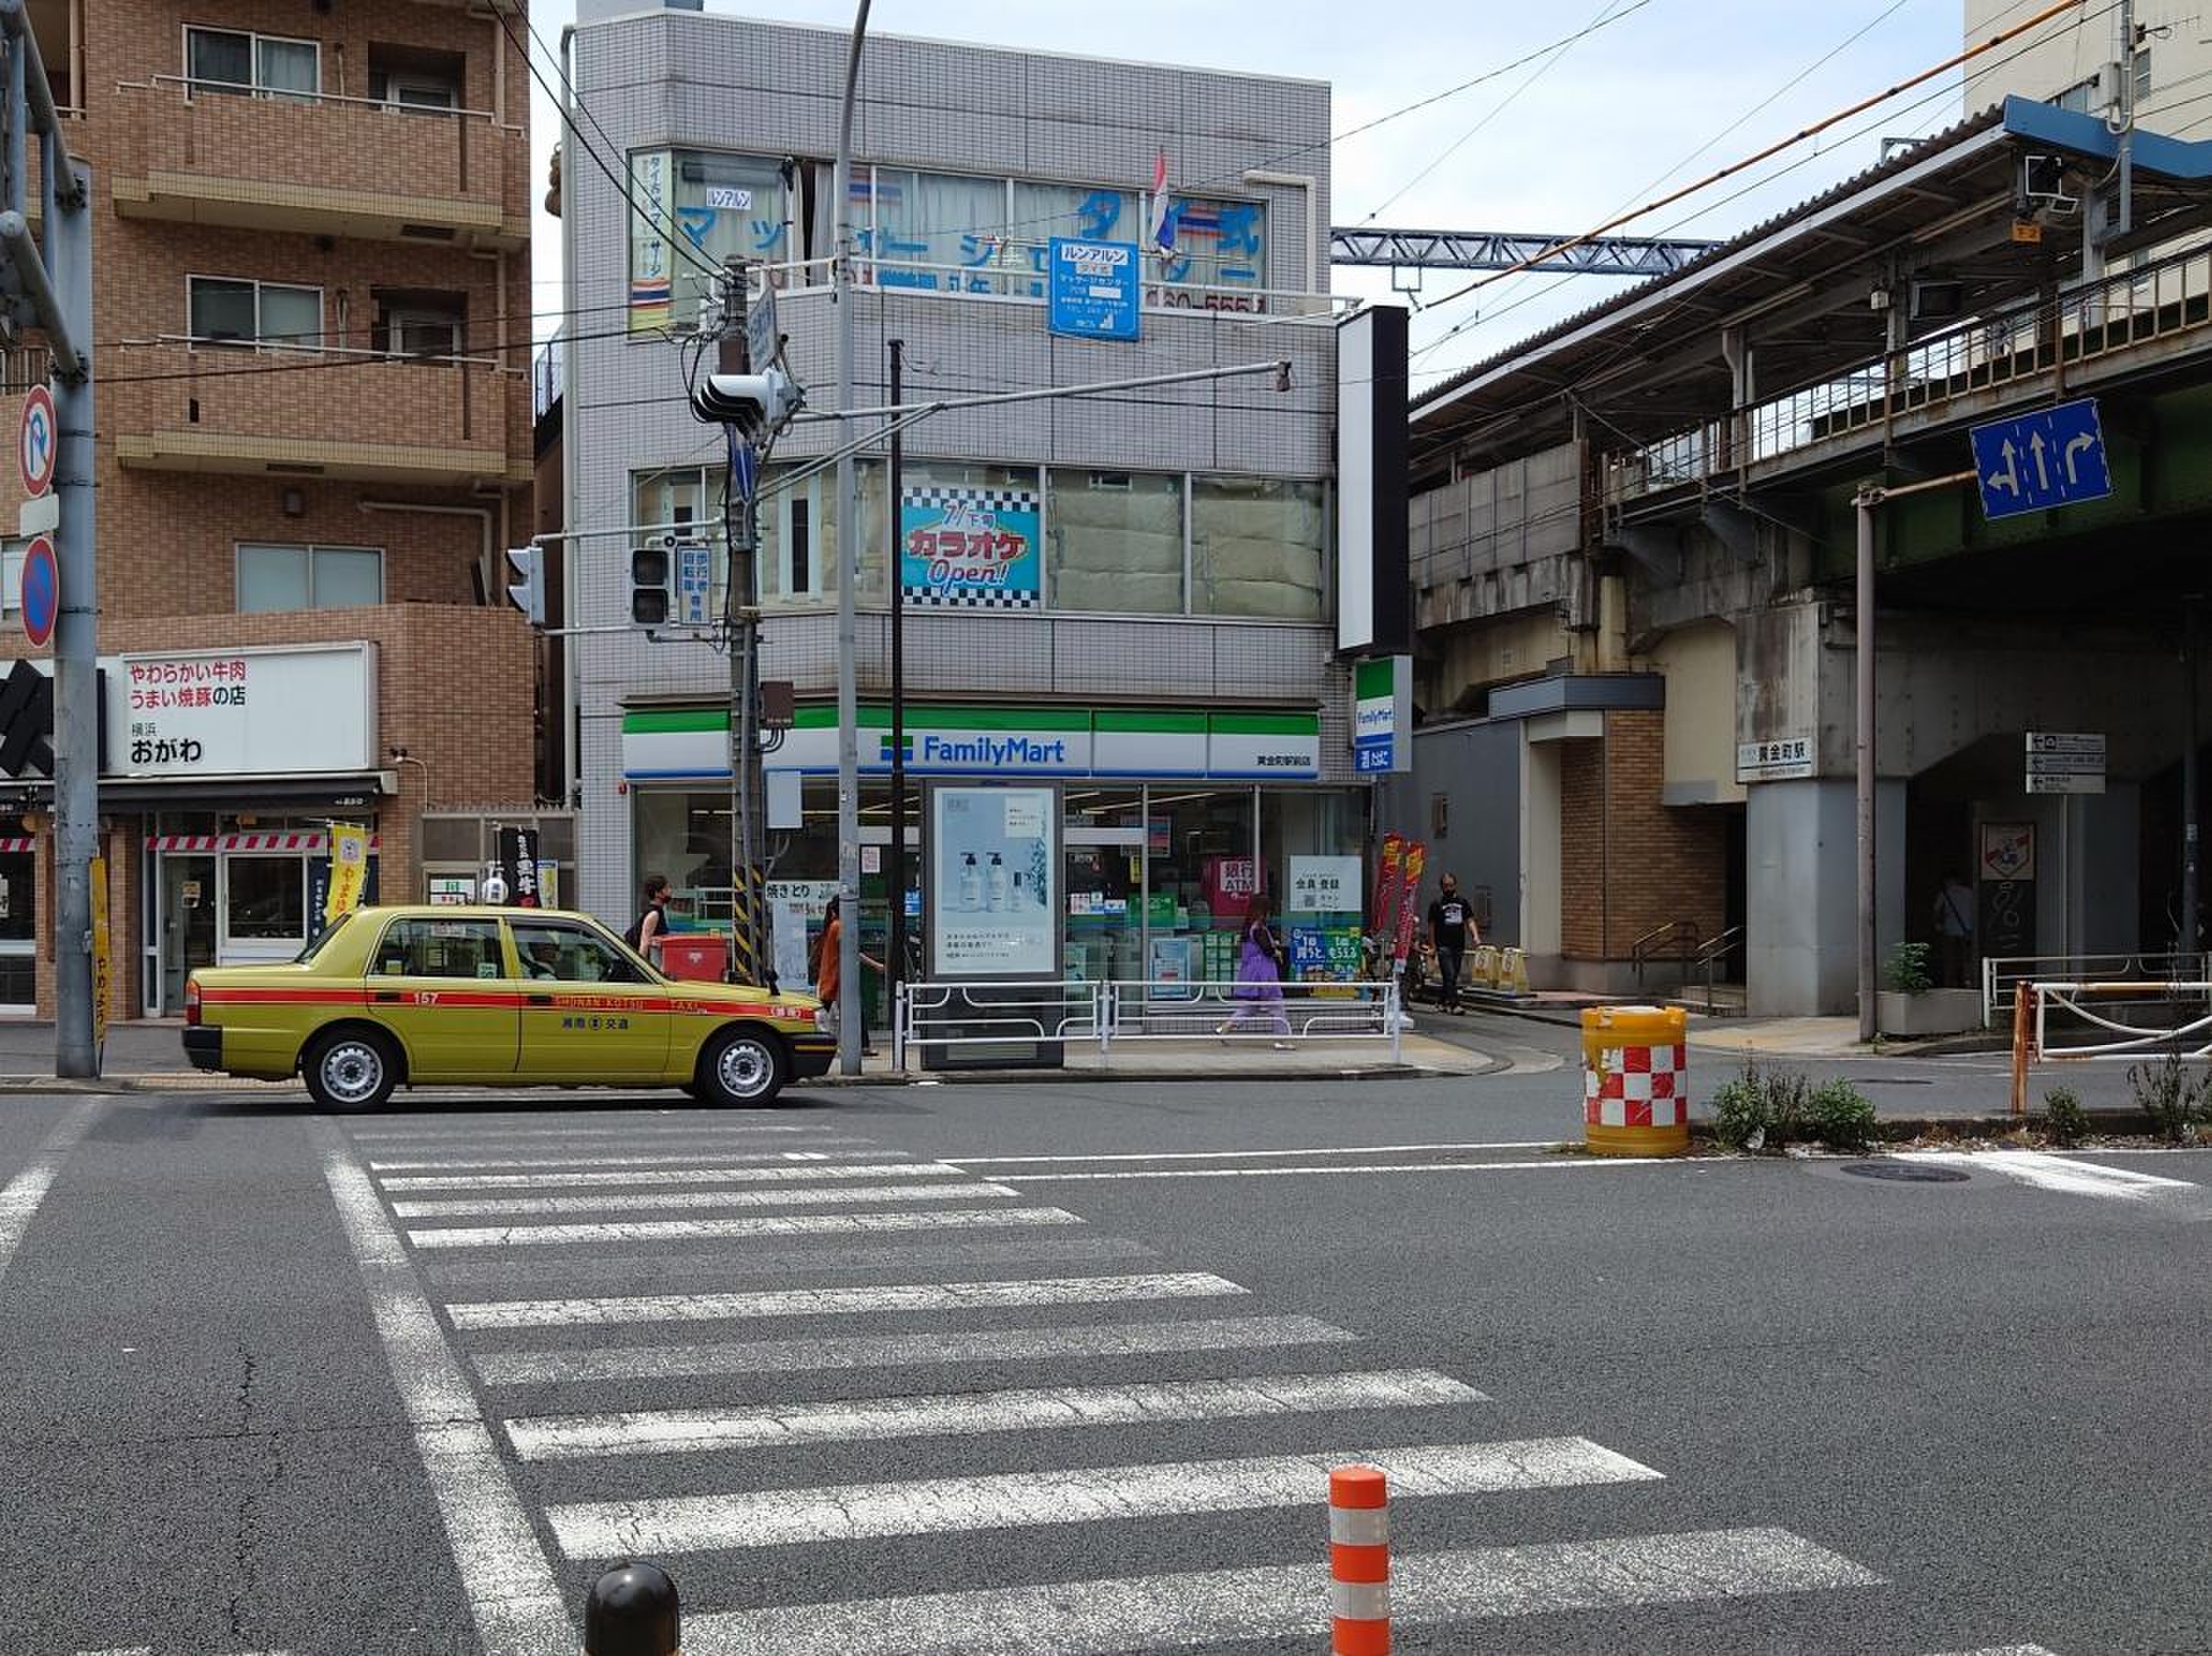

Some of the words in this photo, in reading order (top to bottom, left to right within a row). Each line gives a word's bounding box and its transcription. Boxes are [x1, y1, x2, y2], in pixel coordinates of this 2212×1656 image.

[909, 529, 1026, 559] カラオケ
[929, 559, 1008, 595] Open!
[131, 661, 246, 684] やわらかい牛肉
[131, 685, 246, 708] うまい焼豚の店
[132, 739, 202, 765] おがわ
[924, 735, 1065, 765] FamilyMart
[1758, 741, 1805, 763] 黄金町駅
[413, 992, 439, 1005] 157
